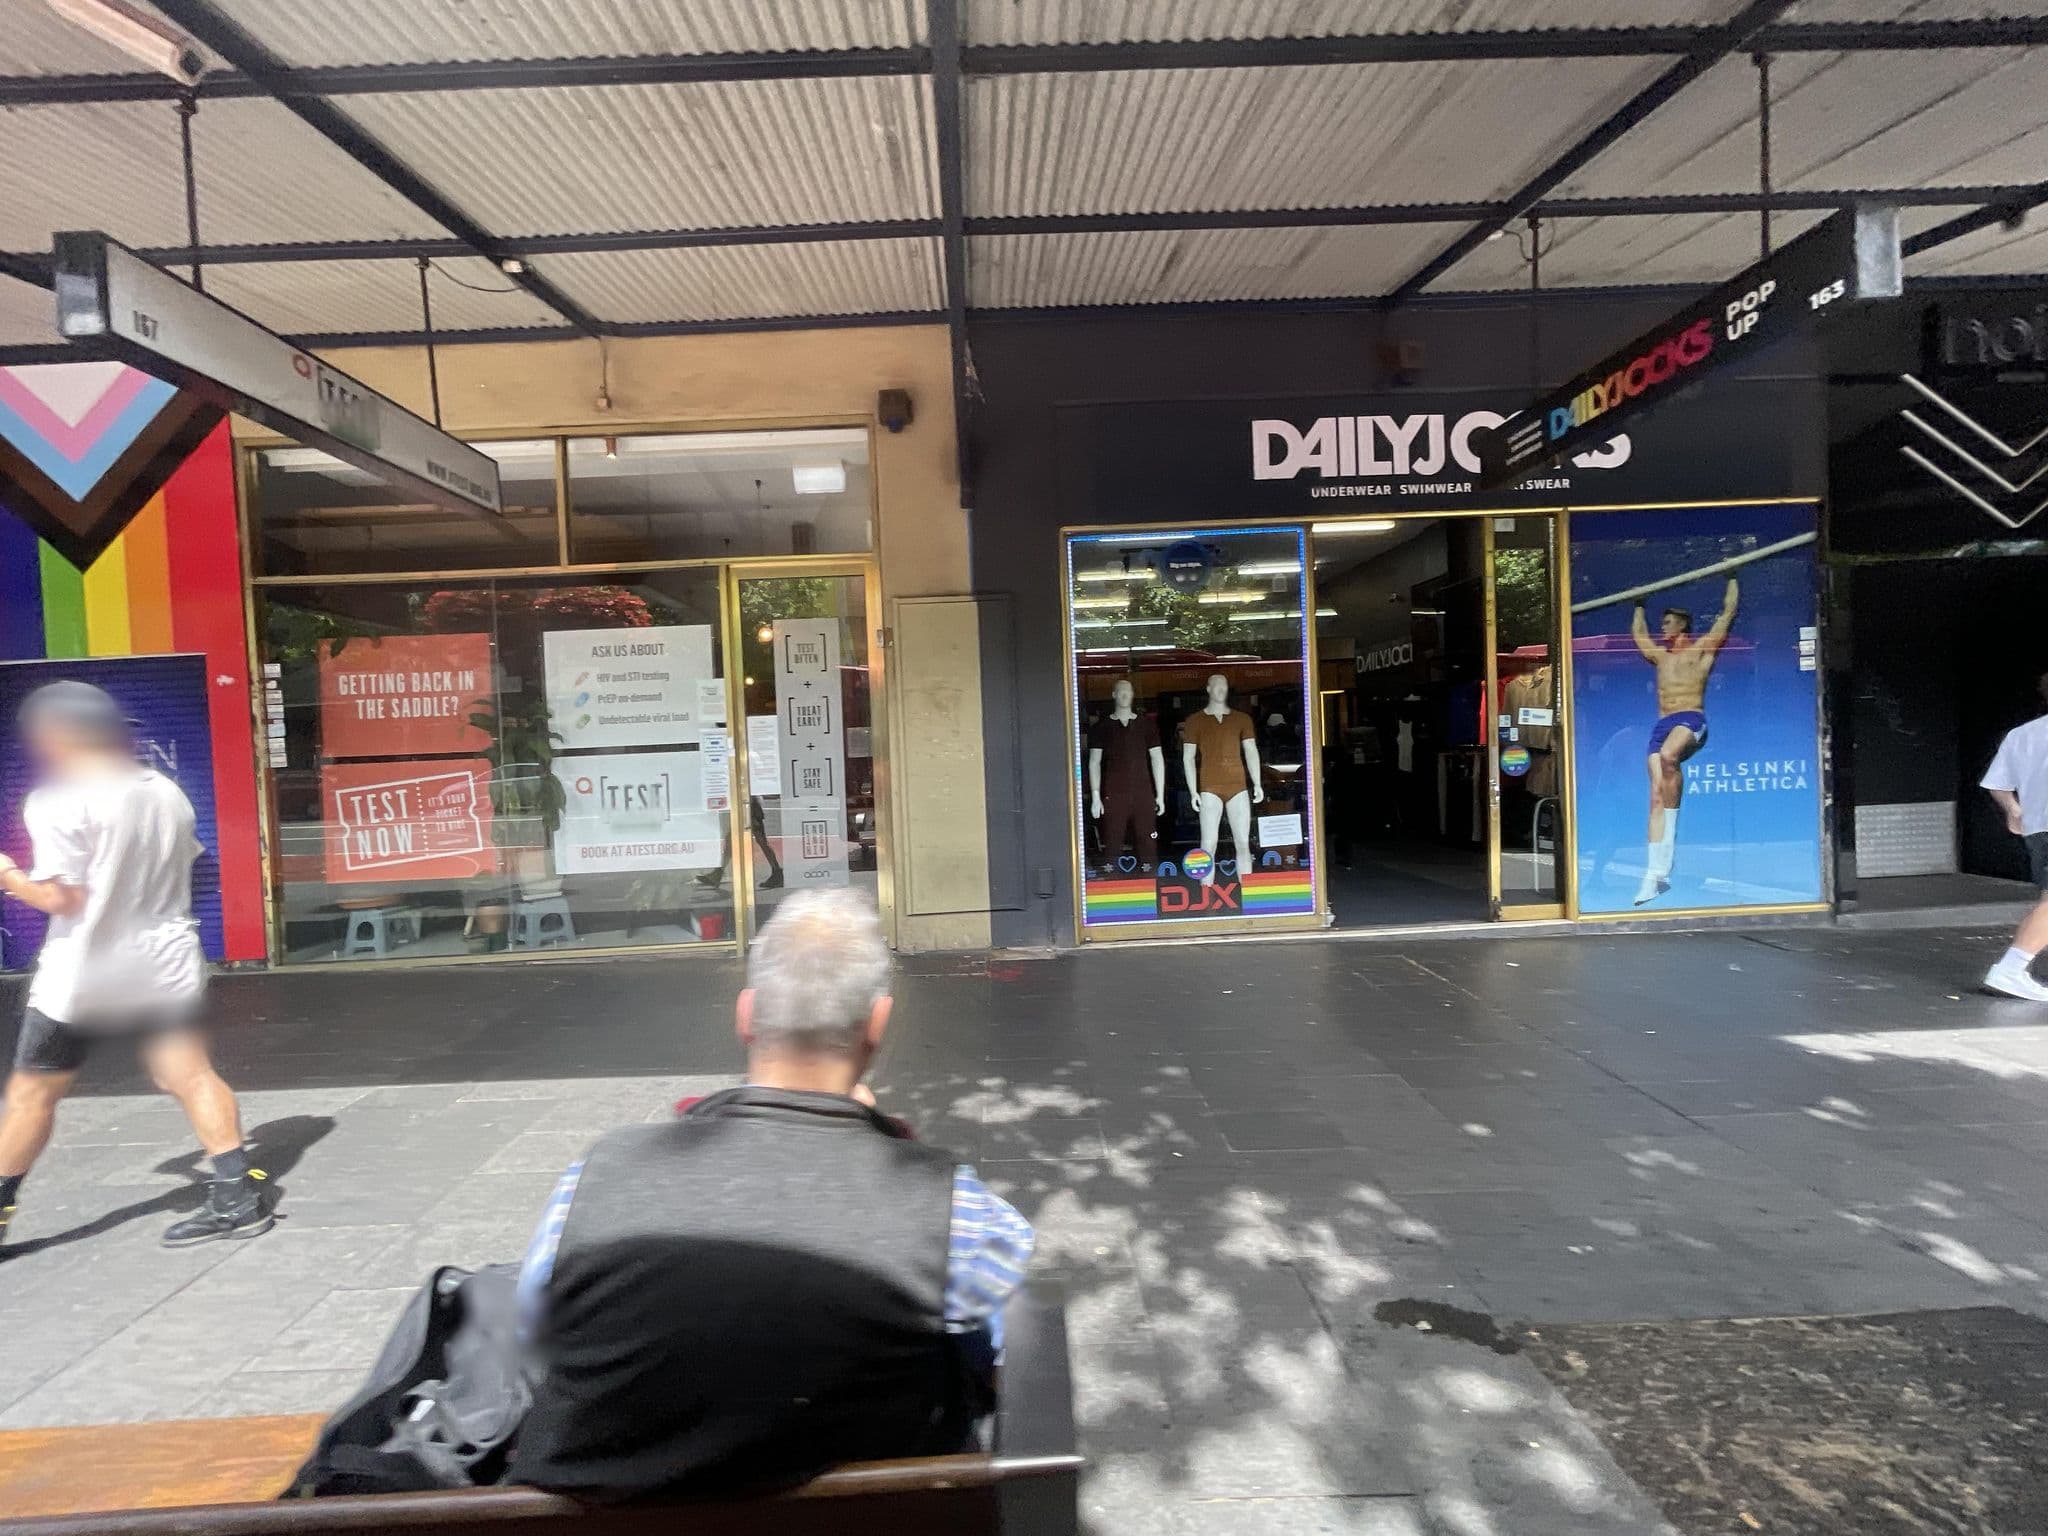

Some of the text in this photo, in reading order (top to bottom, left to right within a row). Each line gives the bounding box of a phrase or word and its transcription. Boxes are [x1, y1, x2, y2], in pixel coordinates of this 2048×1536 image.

[1726, 280, 1776, 321] POP
[1808, 279, 1845, 309] 163
[1726, 312, 1759, 340] UP
[1311, 485, 1391, 498] UNDERWEAR
[1399, 482, 1472, 495] SWIMWEAR
[592, 643, 664, 657] ASK US ABOUT
[338, 670, 475, 696] GETTING BACK IN
[356, 696, 459, 720] THE SADDLE?
[803, 768, 821, 778] STAY
[1688, 760, 1806, 778] HELSINKI
[804, 779, 821, 788] SAFE
[1689, 776, 1808, 794] ATHLETICA
[350, 789, 409, 826] TEST
[356, 823, 414, 861] NOW
[581, 847, 608, 858] BOOK
[611, 845, 625, 856] AT
[1160, 882, 1239, 913] DJX
